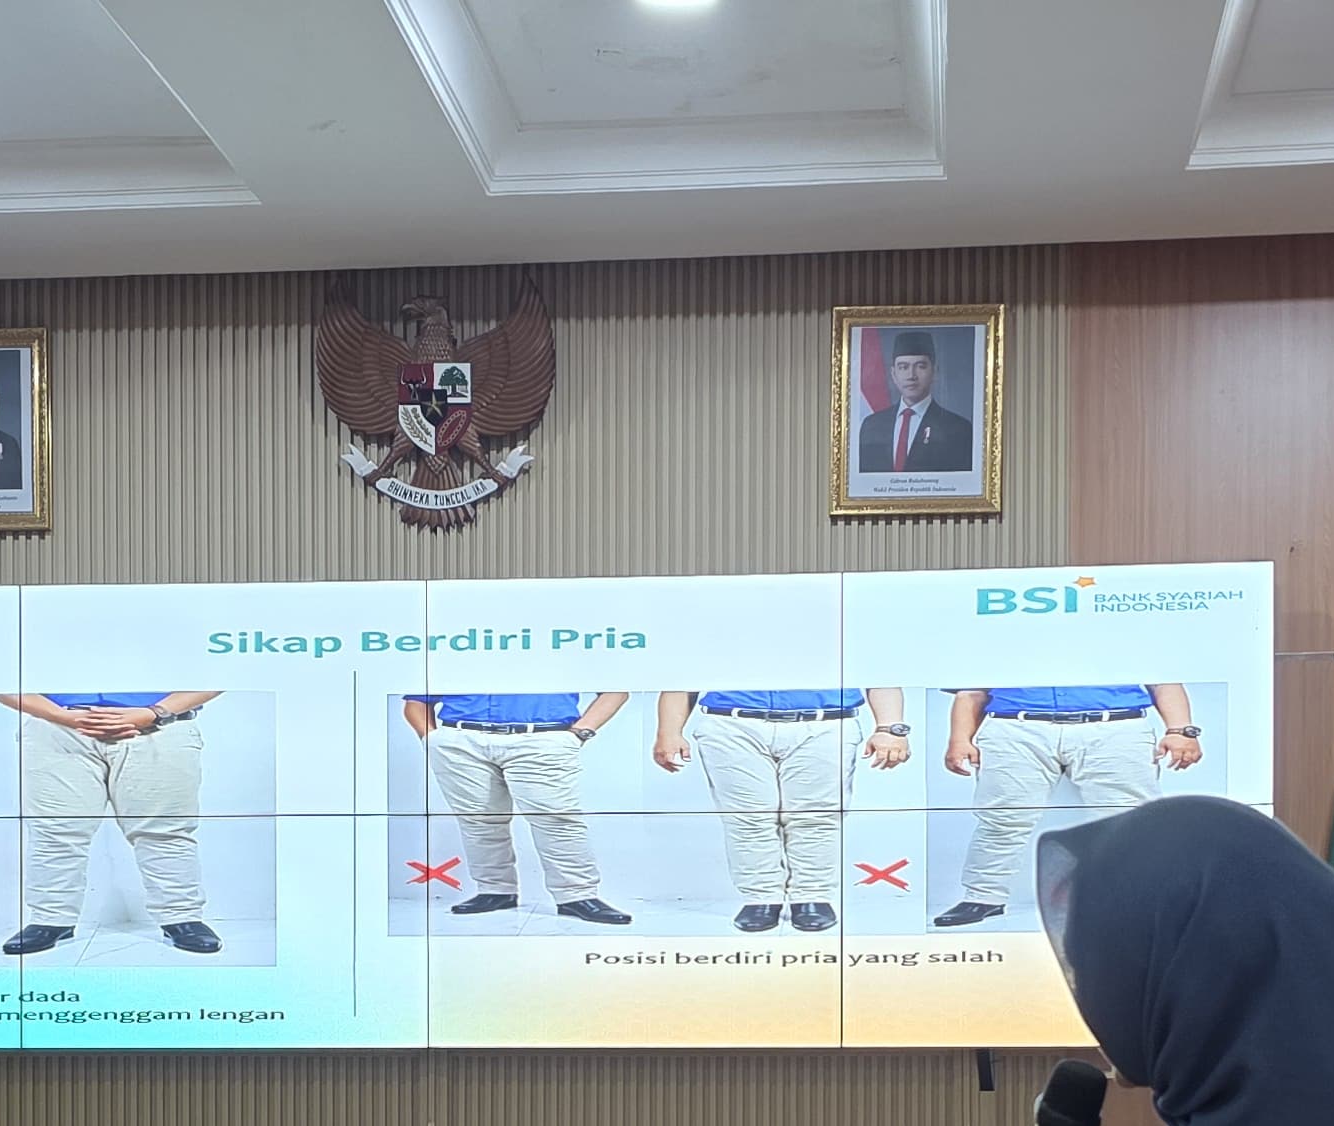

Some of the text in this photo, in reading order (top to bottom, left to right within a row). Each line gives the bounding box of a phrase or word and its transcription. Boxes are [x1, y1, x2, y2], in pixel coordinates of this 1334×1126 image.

[386, 481, 430, 506] BHINNEKA
[473, 481, 488, 496] IKA
[976, 585, 1078, 616] BSI
[1093, 589, 1244, 603] BANK SYARIAH
[1093, 601, 1211, 613] INDONESIA
[207, 627, 647, 659] Sikap Berdiri Pria
[584, 949, 1004, 968] Posisi berdiri pria yang salah
[18, 990, 81, 1003] dada
[199, 1007, 285, 1023] lengan
